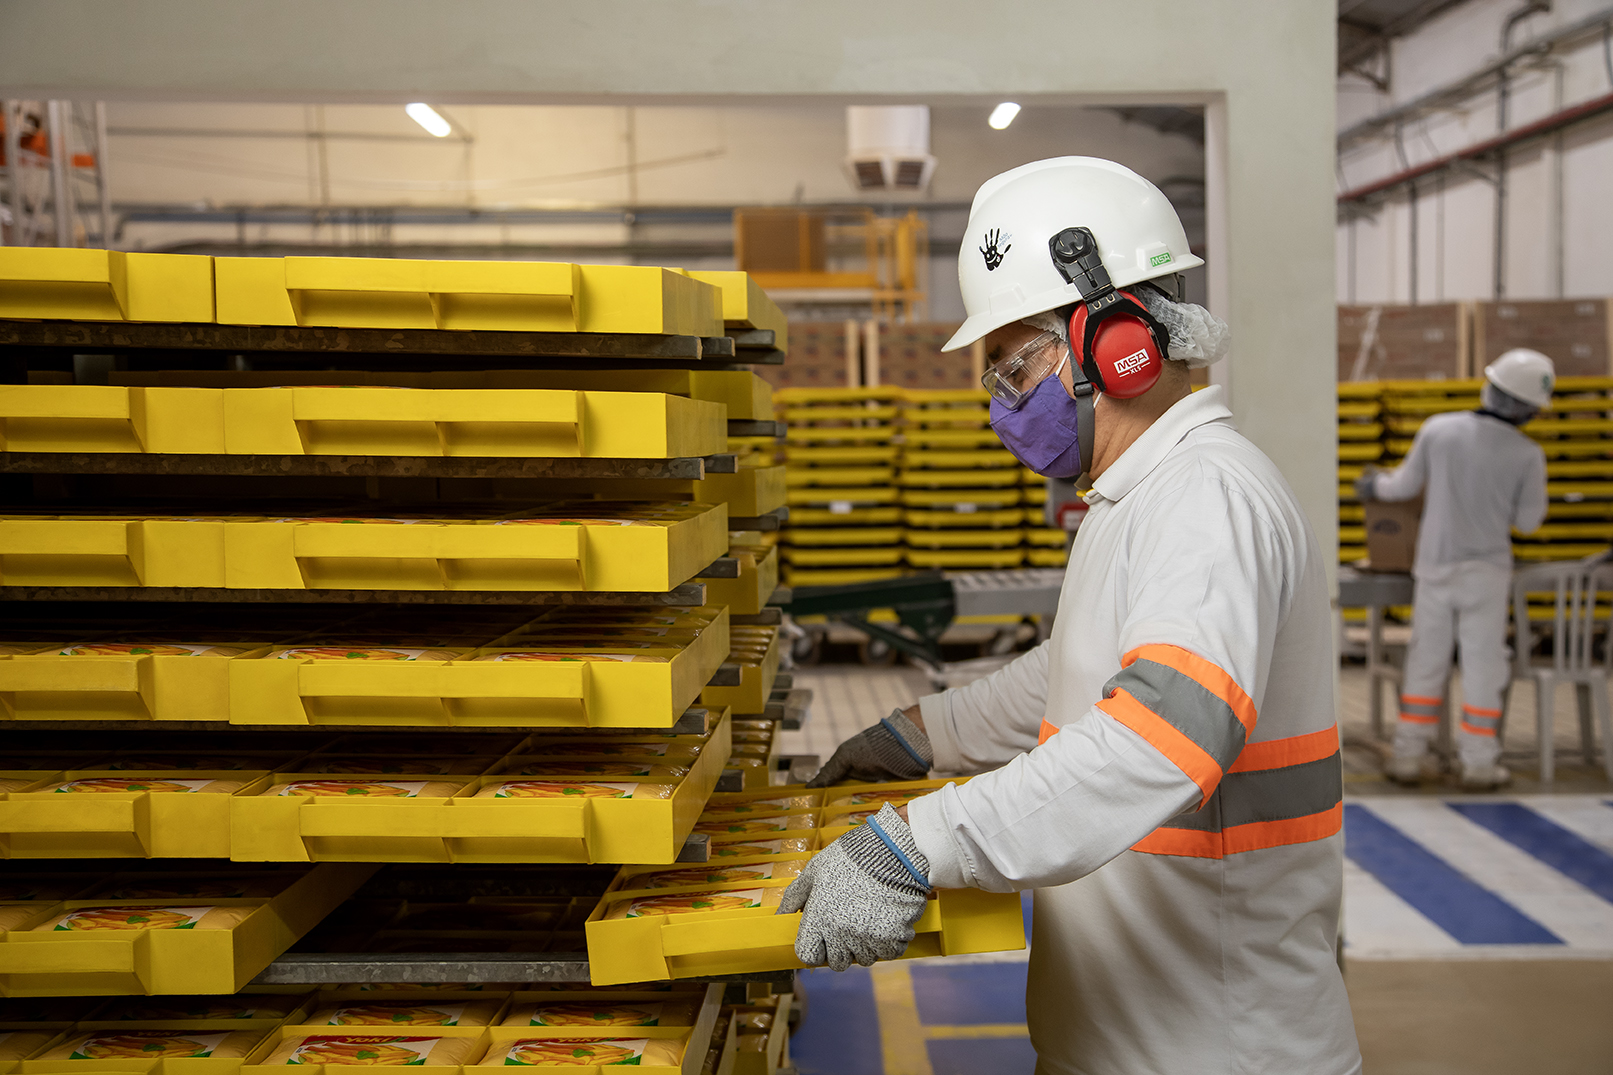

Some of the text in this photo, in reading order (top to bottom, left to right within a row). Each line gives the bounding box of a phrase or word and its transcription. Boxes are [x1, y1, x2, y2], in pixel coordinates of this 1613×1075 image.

[1151, 253, 1171, 266] MSA
[1117, 352, 1147, 371] MSA
[1130, 365, 1142, 374] XLS
